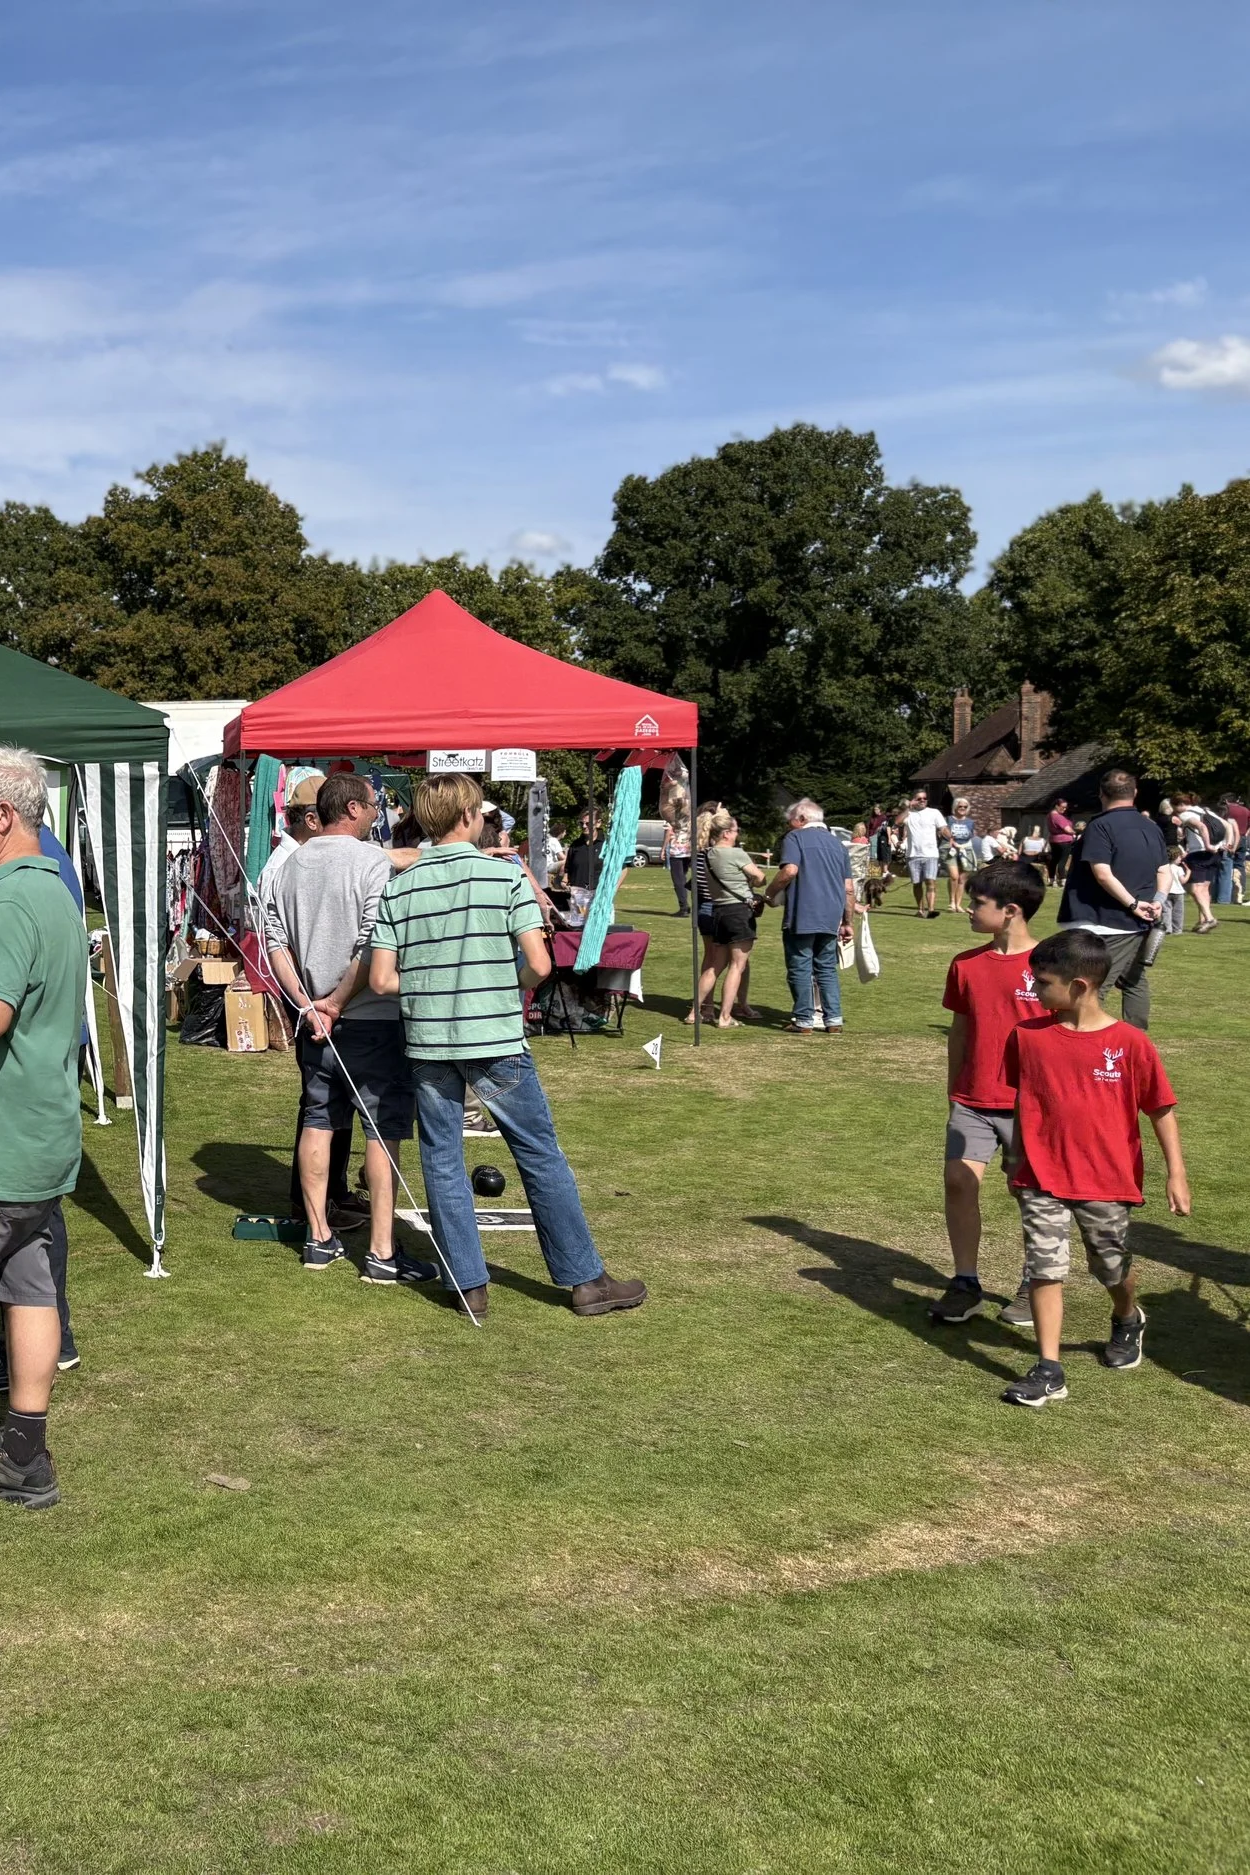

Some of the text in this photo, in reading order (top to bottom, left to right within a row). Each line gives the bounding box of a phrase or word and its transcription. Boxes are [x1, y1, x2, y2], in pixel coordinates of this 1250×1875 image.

[432, 756, 484, 768] Streetkatz
[1014, 988, 1038, 998] Scou
[527, 1002, 542, 1011] SPO
[528, 1011, 543, 1020] DIR
